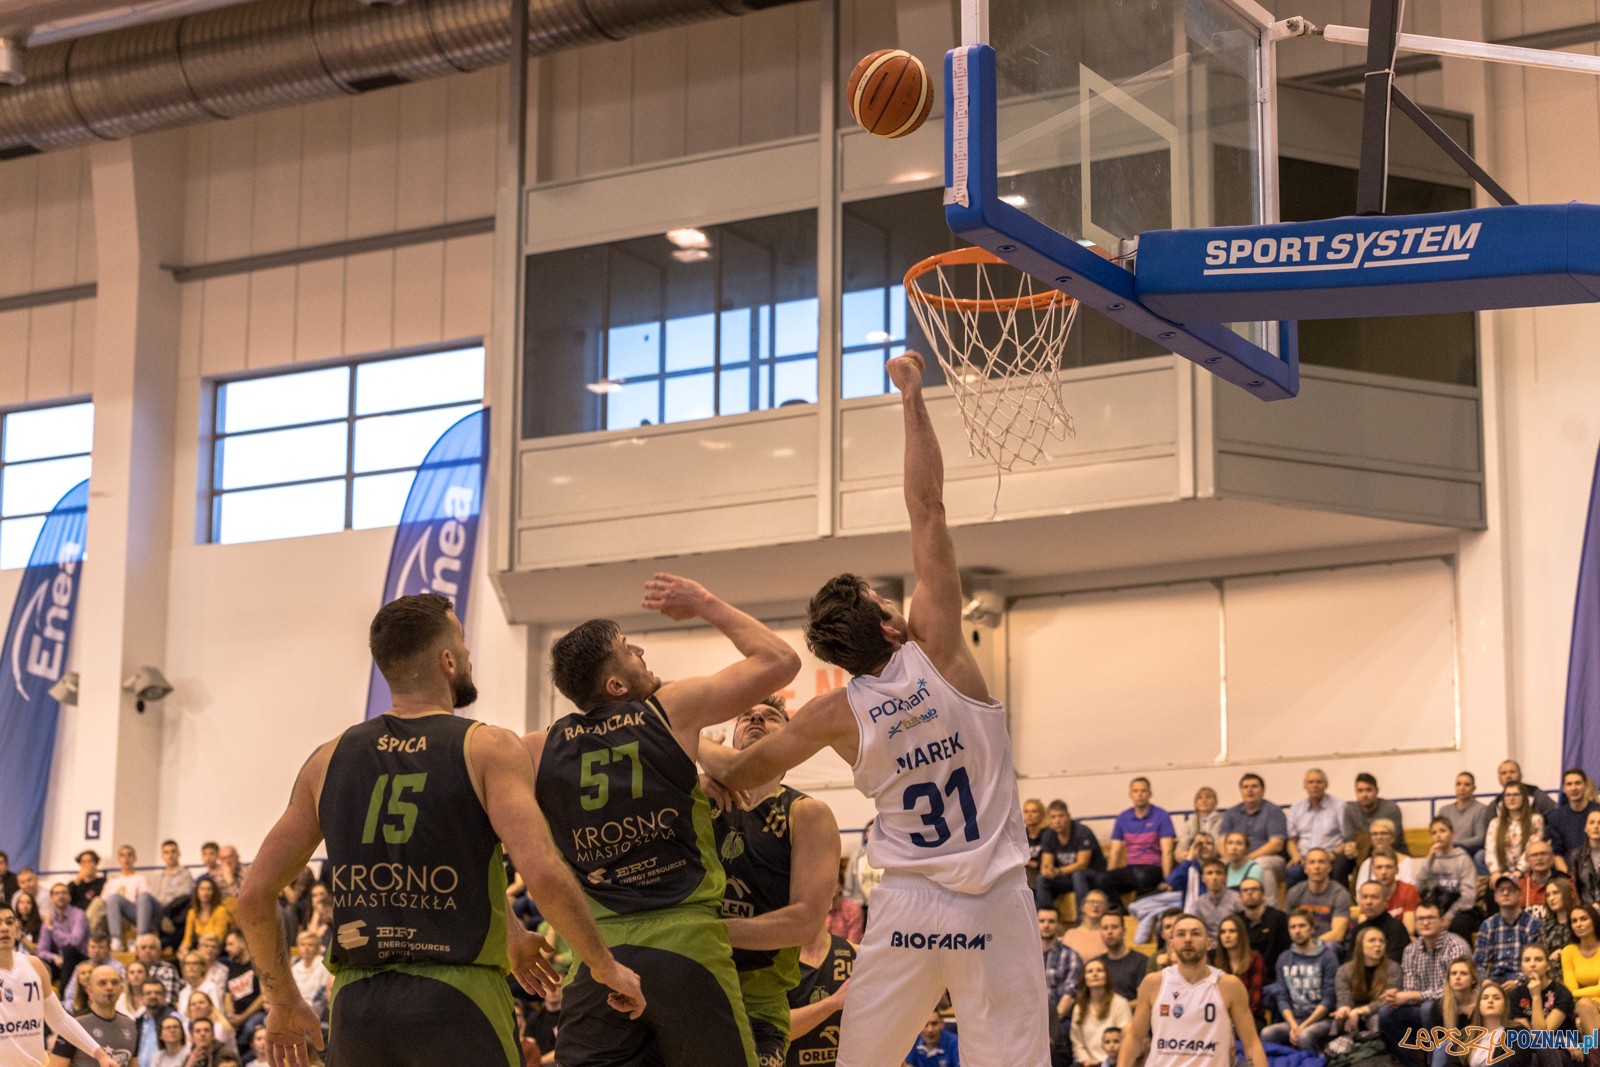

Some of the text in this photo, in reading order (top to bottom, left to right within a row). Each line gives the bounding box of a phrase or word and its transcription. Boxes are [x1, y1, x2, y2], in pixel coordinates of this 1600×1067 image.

[424, 485, 473, 606] nea
[26, 541, 81, 681] Enea
[376, 735, 428, 753] ŚPICA
[580, 741, 643, 811] 57
[361, 772, 428, 844] 15
[903, 766, 980, 848] 31
[572, 807, 679, 851] KROSNO
[577, 841, 631, 863] MIASTO
[615, 856, 658, 878] ERU
[332, 862, 459, 894] KROSNO
[23, 980, 41, 1002] 71
[1204, 1002, 1216, 1023] 0
[801, 1049, 838, 1064] ORLE
